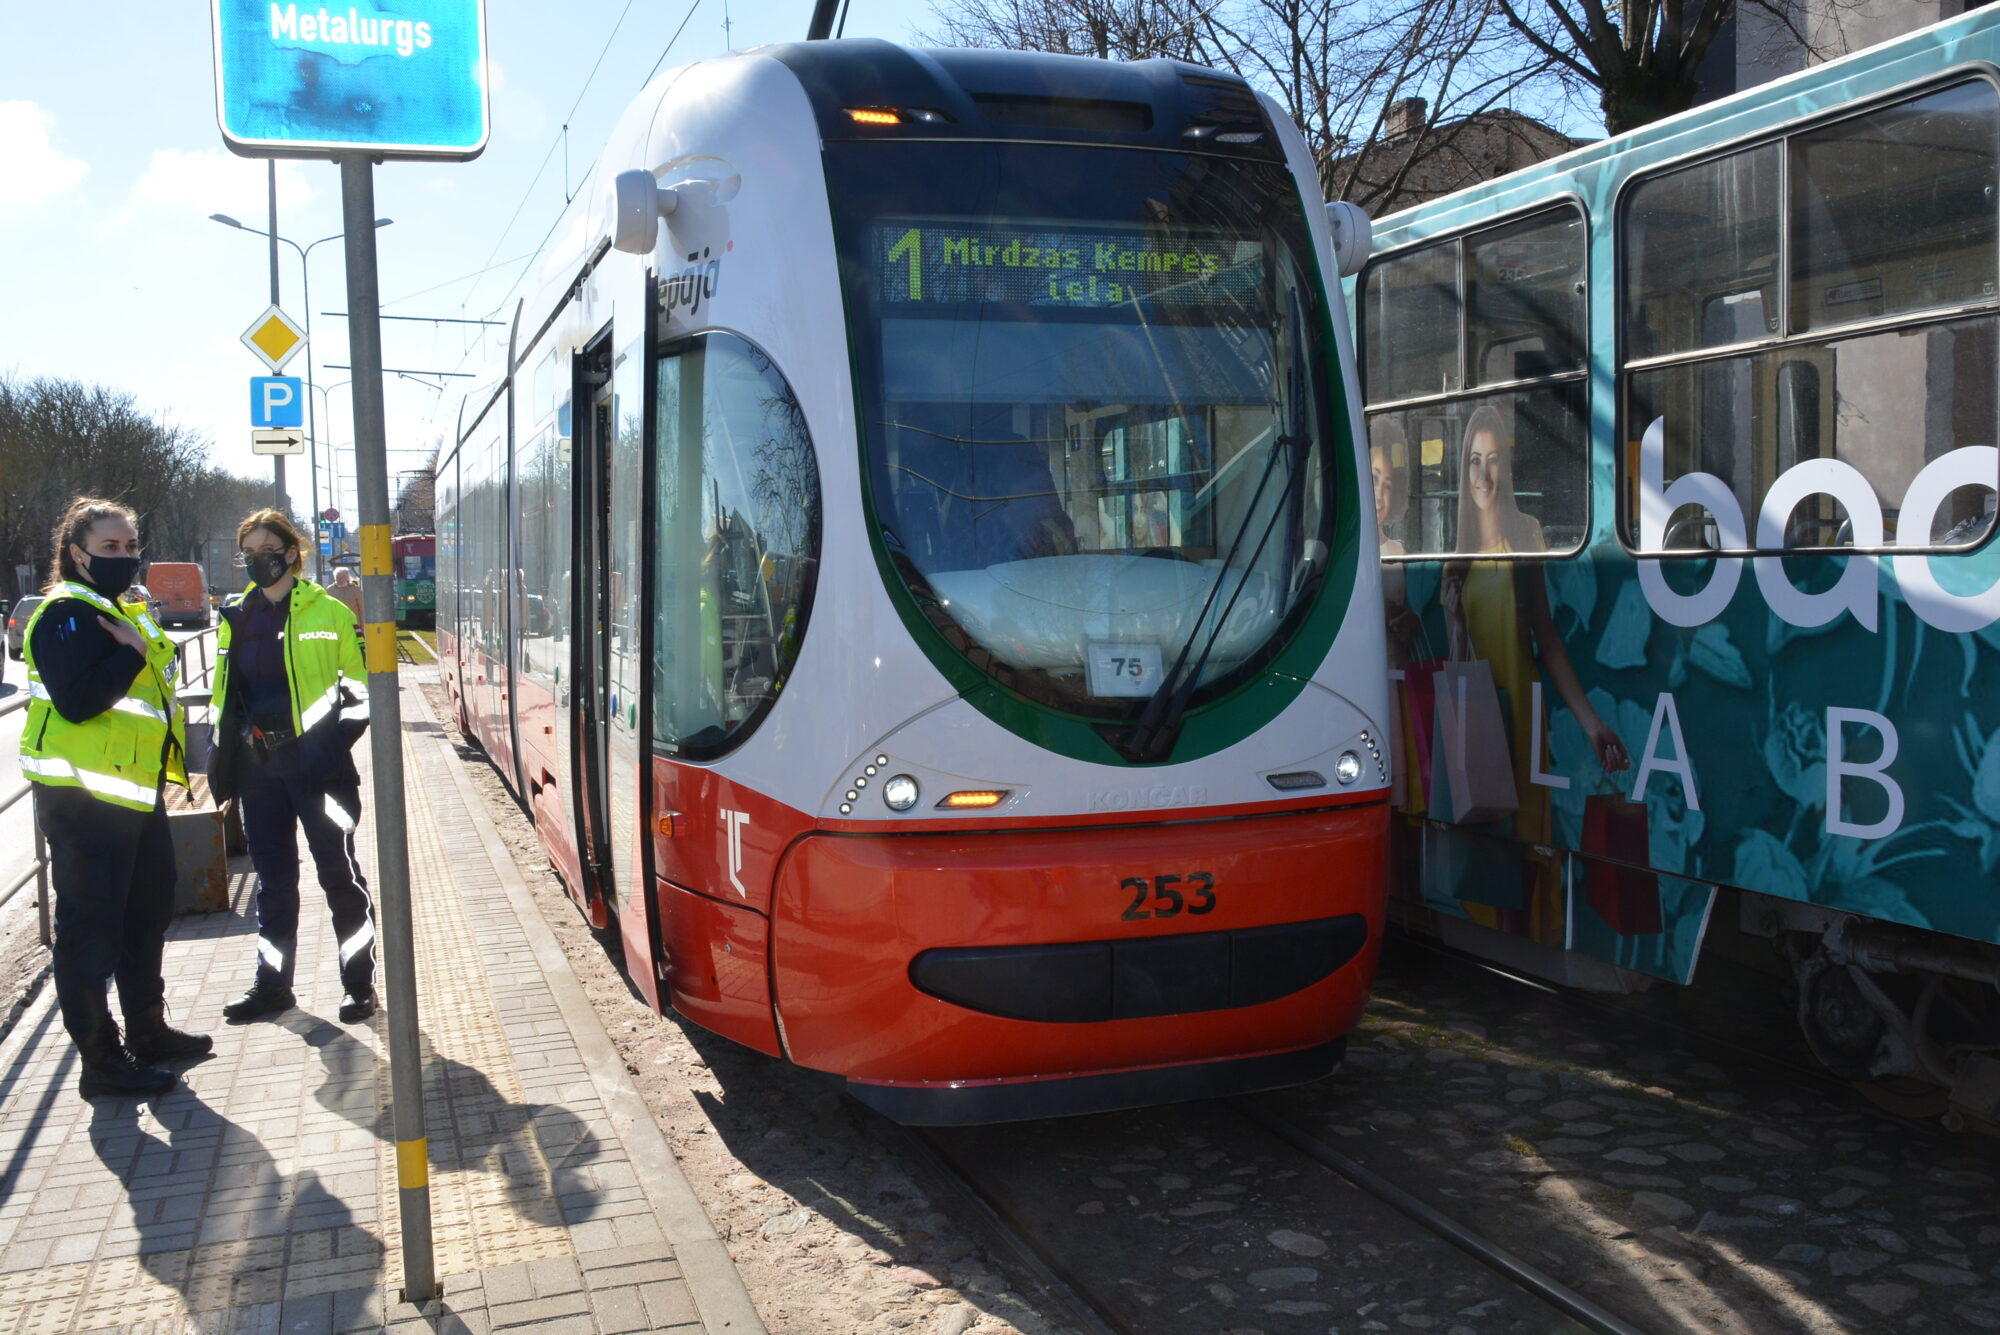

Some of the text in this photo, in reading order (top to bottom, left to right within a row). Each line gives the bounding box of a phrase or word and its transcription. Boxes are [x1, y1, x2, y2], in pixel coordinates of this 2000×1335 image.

[270, 2, 433, 57] Metalurgs
[888, 228, 922, 301] 1
[943, 236, 1081, 269] Mirdzas
[1048, 273, 1124, 302] iela
[263, 382, 294, 422] P
[1110, 657, 1143, 677] 75
[1120, 871, 1218, 922] 253
